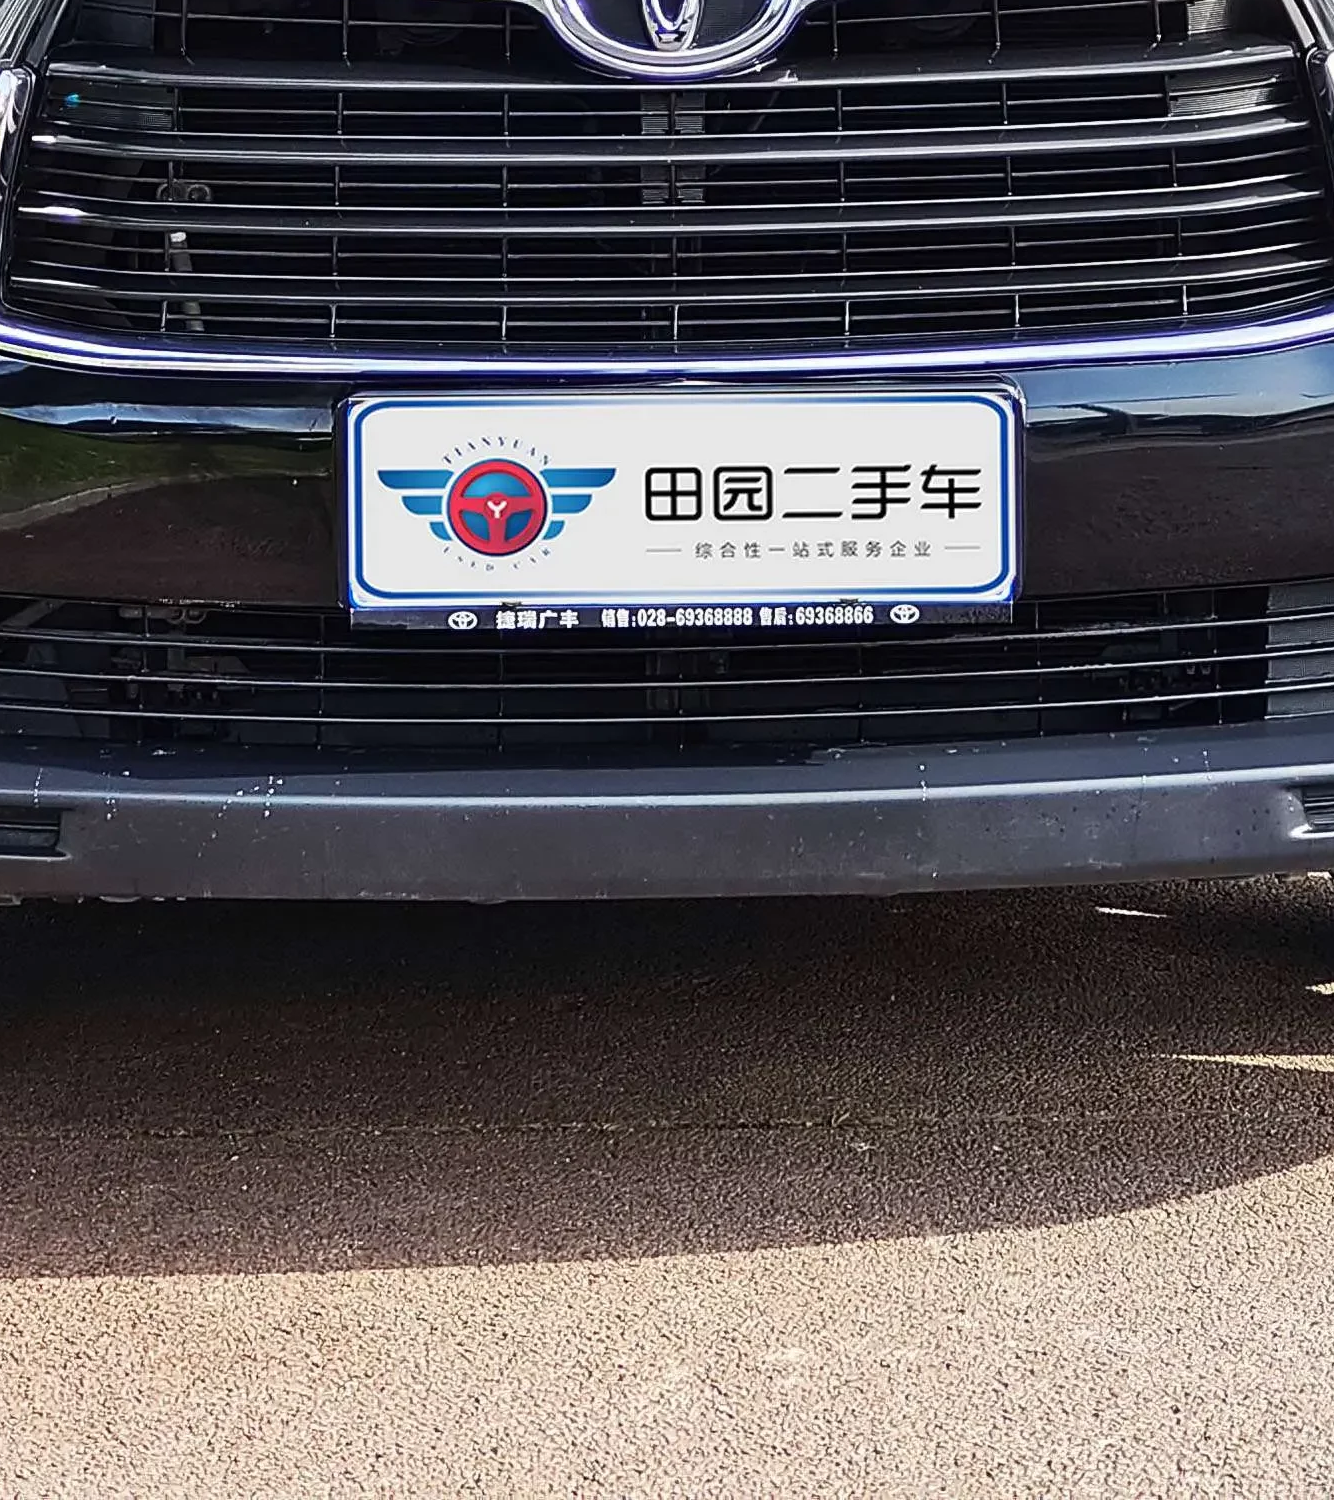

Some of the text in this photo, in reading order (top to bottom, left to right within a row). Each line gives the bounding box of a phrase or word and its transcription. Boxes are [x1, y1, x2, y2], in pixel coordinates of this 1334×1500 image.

[644, 463, 983, 522] 田园二手车
[694, 540, 932, 560] 综合性一站式服务企业
